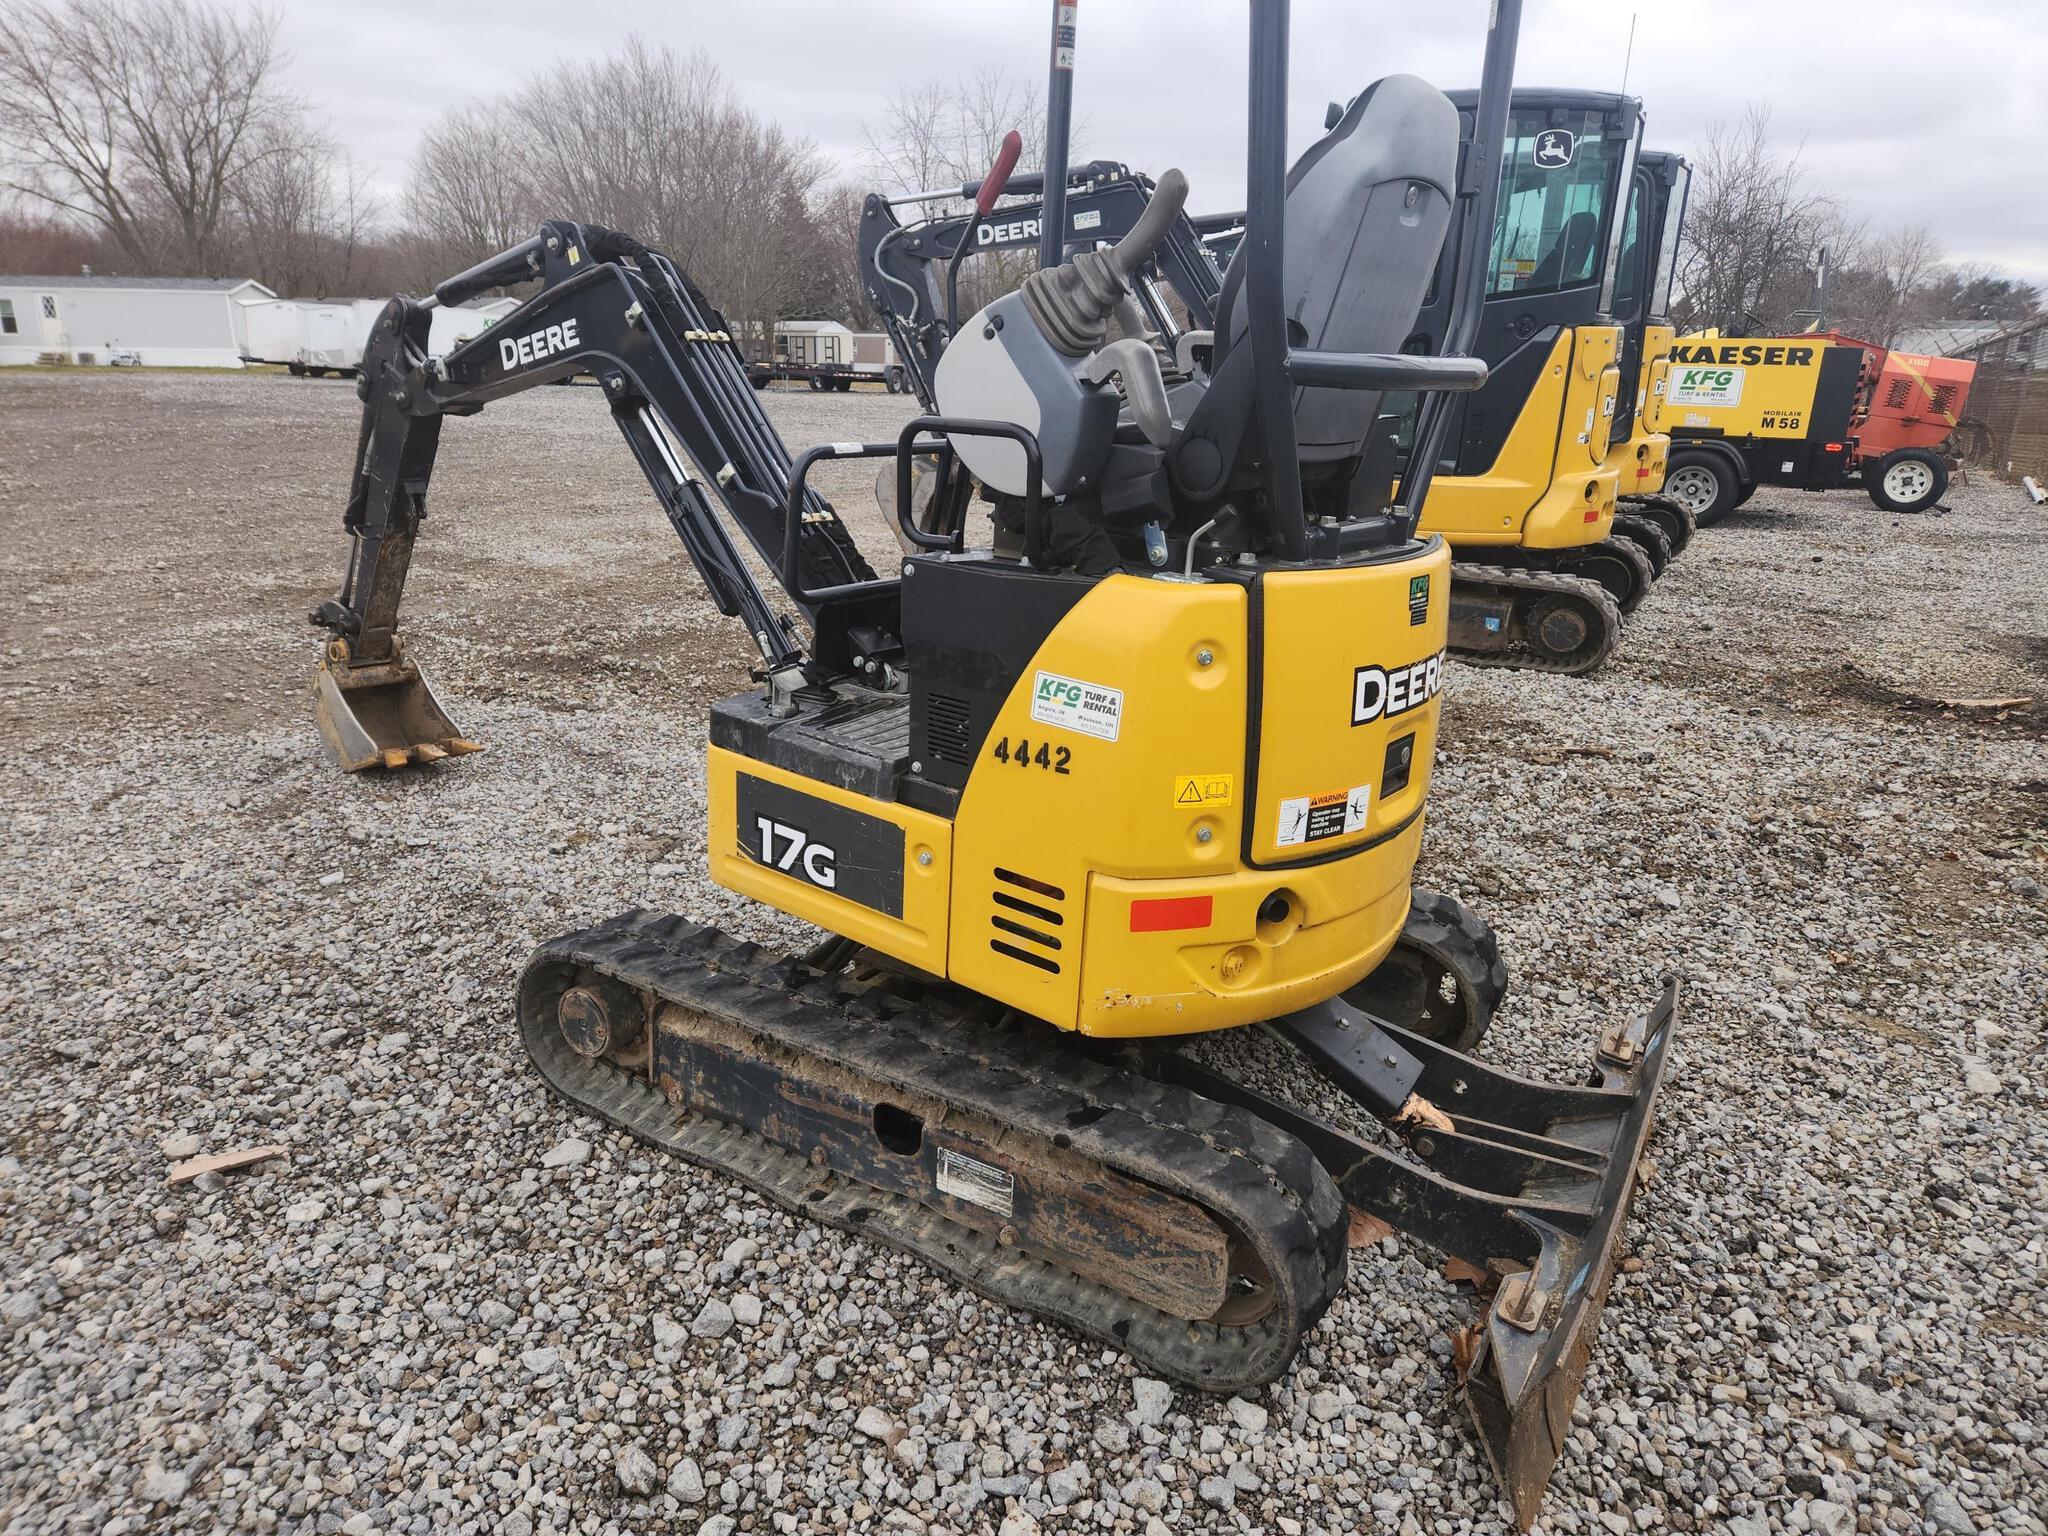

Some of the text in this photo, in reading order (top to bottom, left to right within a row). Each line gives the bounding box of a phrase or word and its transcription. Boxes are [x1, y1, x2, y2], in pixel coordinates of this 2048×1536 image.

[977, 218, 1042, 246] DEER
[499, 317, 580, 371] DEERE
[1668, 345, 1814, 366] KAESER
[1682, 370, 1734, 386] KFG
[1761, 417, 1800, 429] M 58
[1411, 576, 1429, 593] KFG
[1039, 678, 1082, 702] KFG
[1084, 690, 1117, 706] TURF &
[1083, 701, 1117, 716] RENTAL
[994, 736, 1071, 775] 4442
[1317, 792, 1348, 803] WARNING
[1324, 826, 1341, 834] CLEAR
[758, 817, 835, 888] 17G
